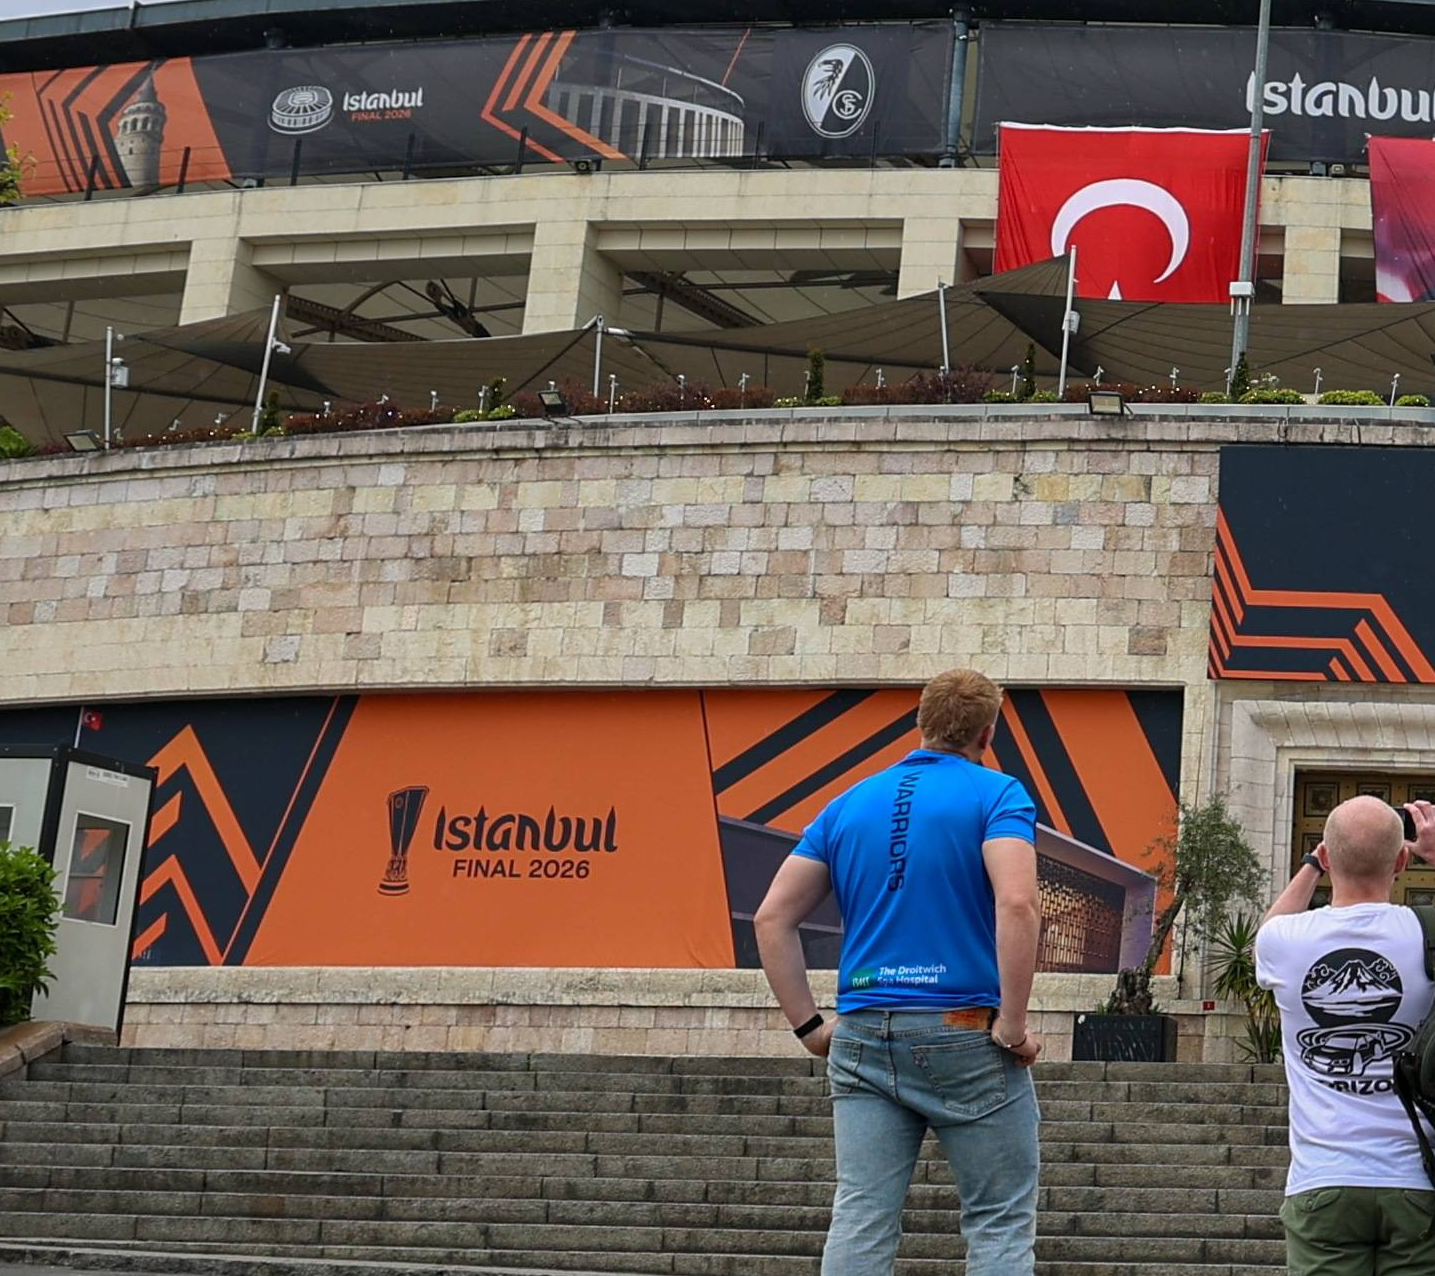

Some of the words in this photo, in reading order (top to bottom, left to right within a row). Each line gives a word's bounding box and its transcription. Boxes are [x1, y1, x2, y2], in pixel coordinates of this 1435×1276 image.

[343, 87, 424, 112] Istanbul
[350, 109, 382, 122] FINAL
[384, 108, 412, 120] 2026
[433, 805, 618, 853] Istanbul
[887, 770, 924, 892] WARRIORS
[452, 858, 522, 878] FINAL
[527, 858, 591, 879] 2026
[879, 967, 896, 976] The
[897, 964, 947, 975] Droitwich
[895, 974, 939, 985] Hospital
